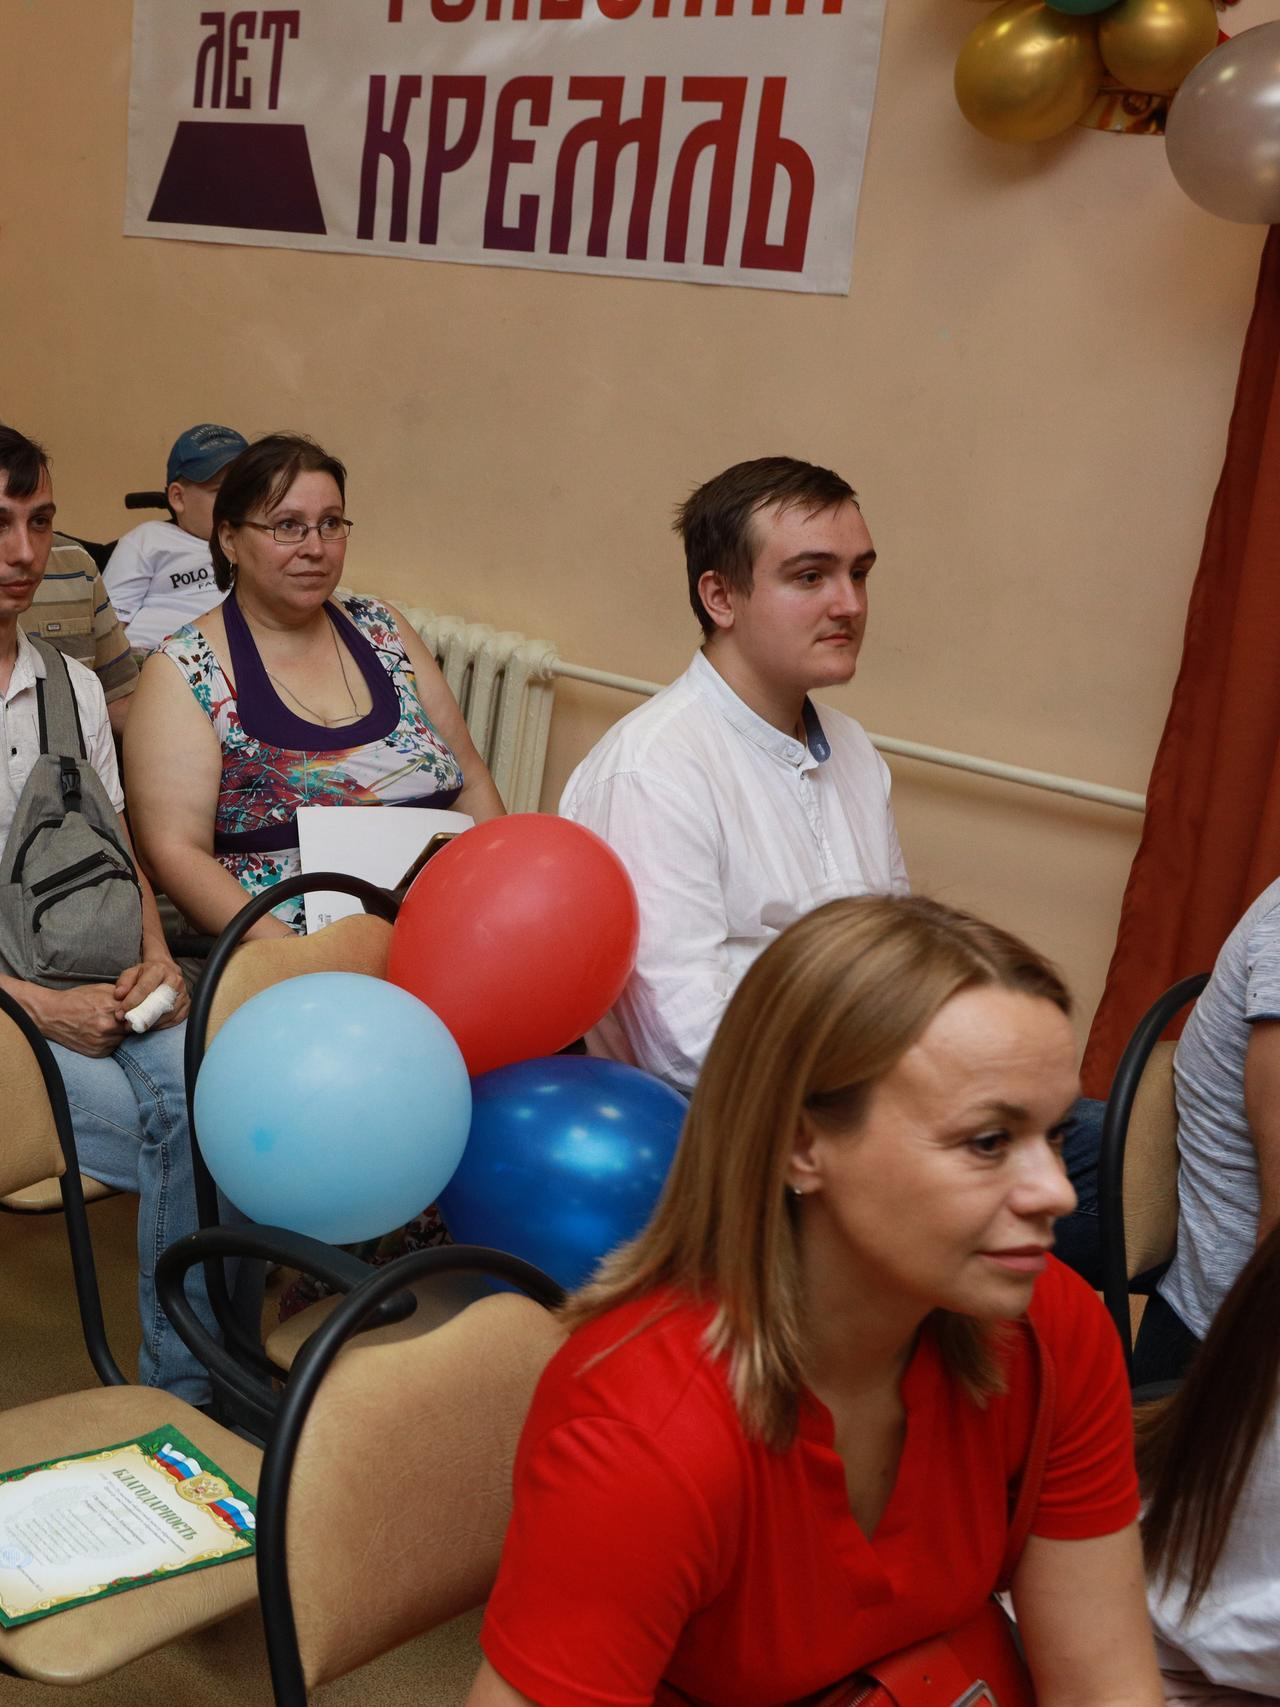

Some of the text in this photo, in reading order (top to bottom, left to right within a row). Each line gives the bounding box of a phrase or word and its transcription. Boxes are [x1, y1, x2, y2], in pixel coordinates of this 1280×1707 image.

[193, 10, 300, 110] ЛЕТ
[356, 74, 816, 273] КРЕМЛЬ
[170, 568, 208, 589] POLO
[113, 1468, 198, 1540] БЛАГОДАРНОСТЬ
